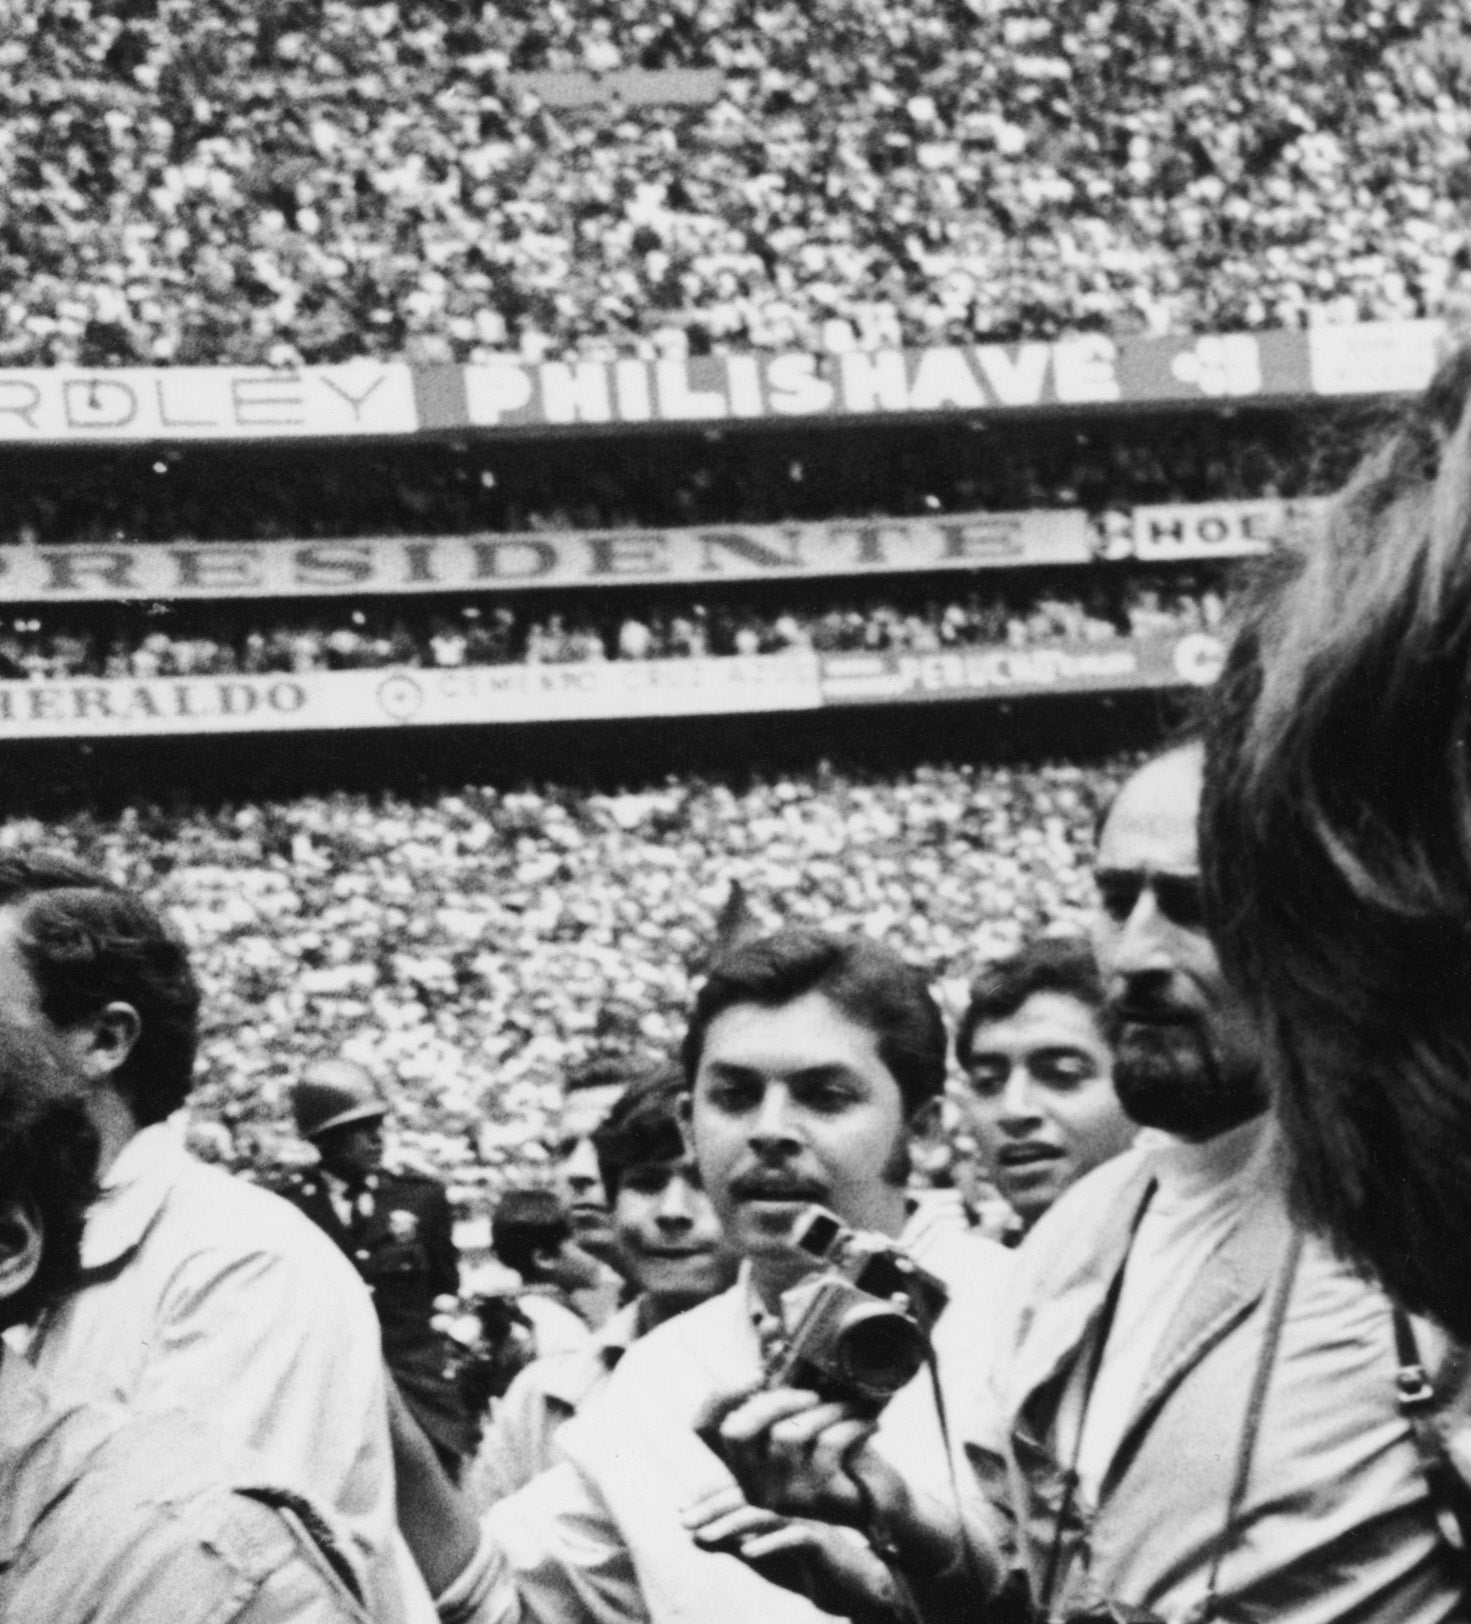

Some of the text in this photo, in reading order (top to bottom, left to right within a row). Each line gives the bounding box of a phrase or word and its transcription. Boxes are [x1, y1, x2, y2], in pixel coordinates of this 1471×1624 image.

[0, 375, 386, 428] RDLEY
[464, 336, 1120, 424] PHILISHAVE
[0, 528, 1022, 592] RESIDENTE
